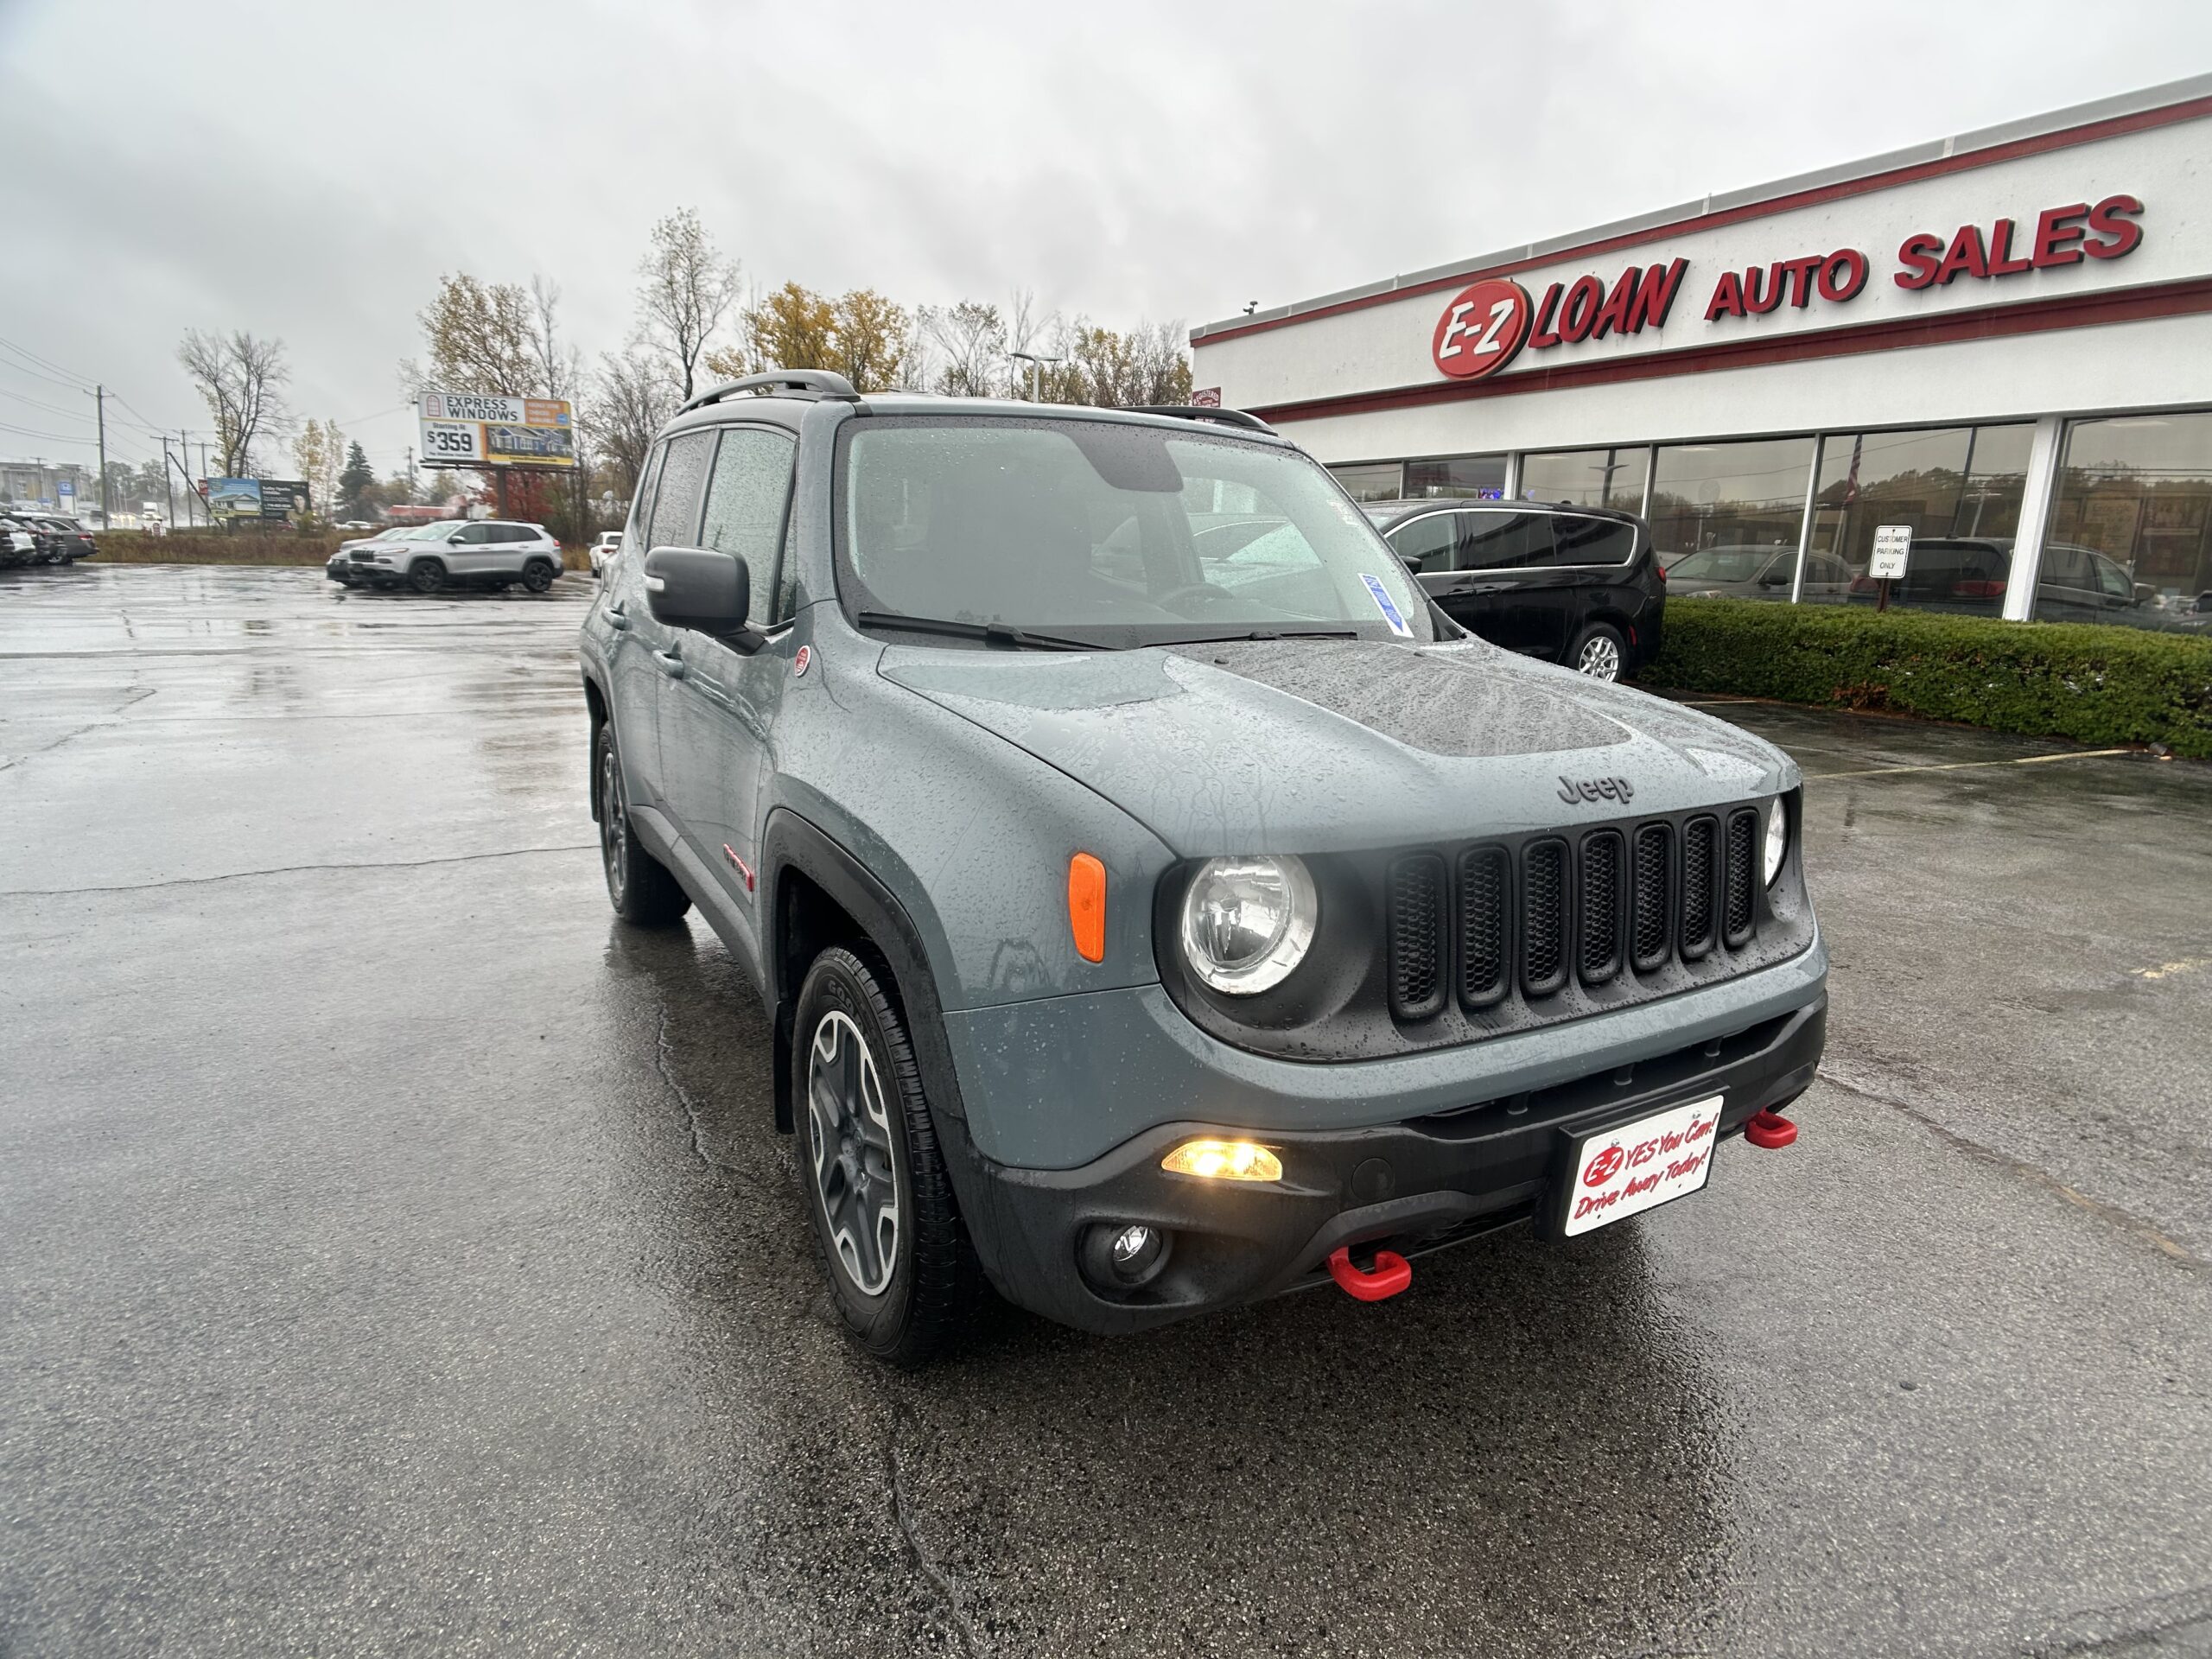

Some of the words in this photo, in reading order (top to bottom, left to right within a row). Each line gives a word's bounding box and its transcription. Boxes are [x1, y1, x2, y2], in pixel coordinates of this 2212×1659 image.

[1438, 298, 1515, 360] E-Z
[1528, 257, 1691, 349] LOAN
[1704, 248, 1870, 321] AUTO
[1894, 194, 2145, 290] SALES
[446, 396, 508, 410] EXPRESS
[448, 407, 518, 422] WINDOWS
[427, 430, 473, 452] $359
[1556, 775, 1635, 804] Jeep
[1586, 1150, 1623, 1184] E-Z
[1624, 1138, 1659, 1170] YES
[1658, 1131, 1684, 1156] You
[1684, 1112, 1719, 1144] Can!
[1573, 1191, 1620, 1220] Drive
[1620, 1171, 1664, 1200] Away
[1665, 1147, 1711, 1181] Today!
